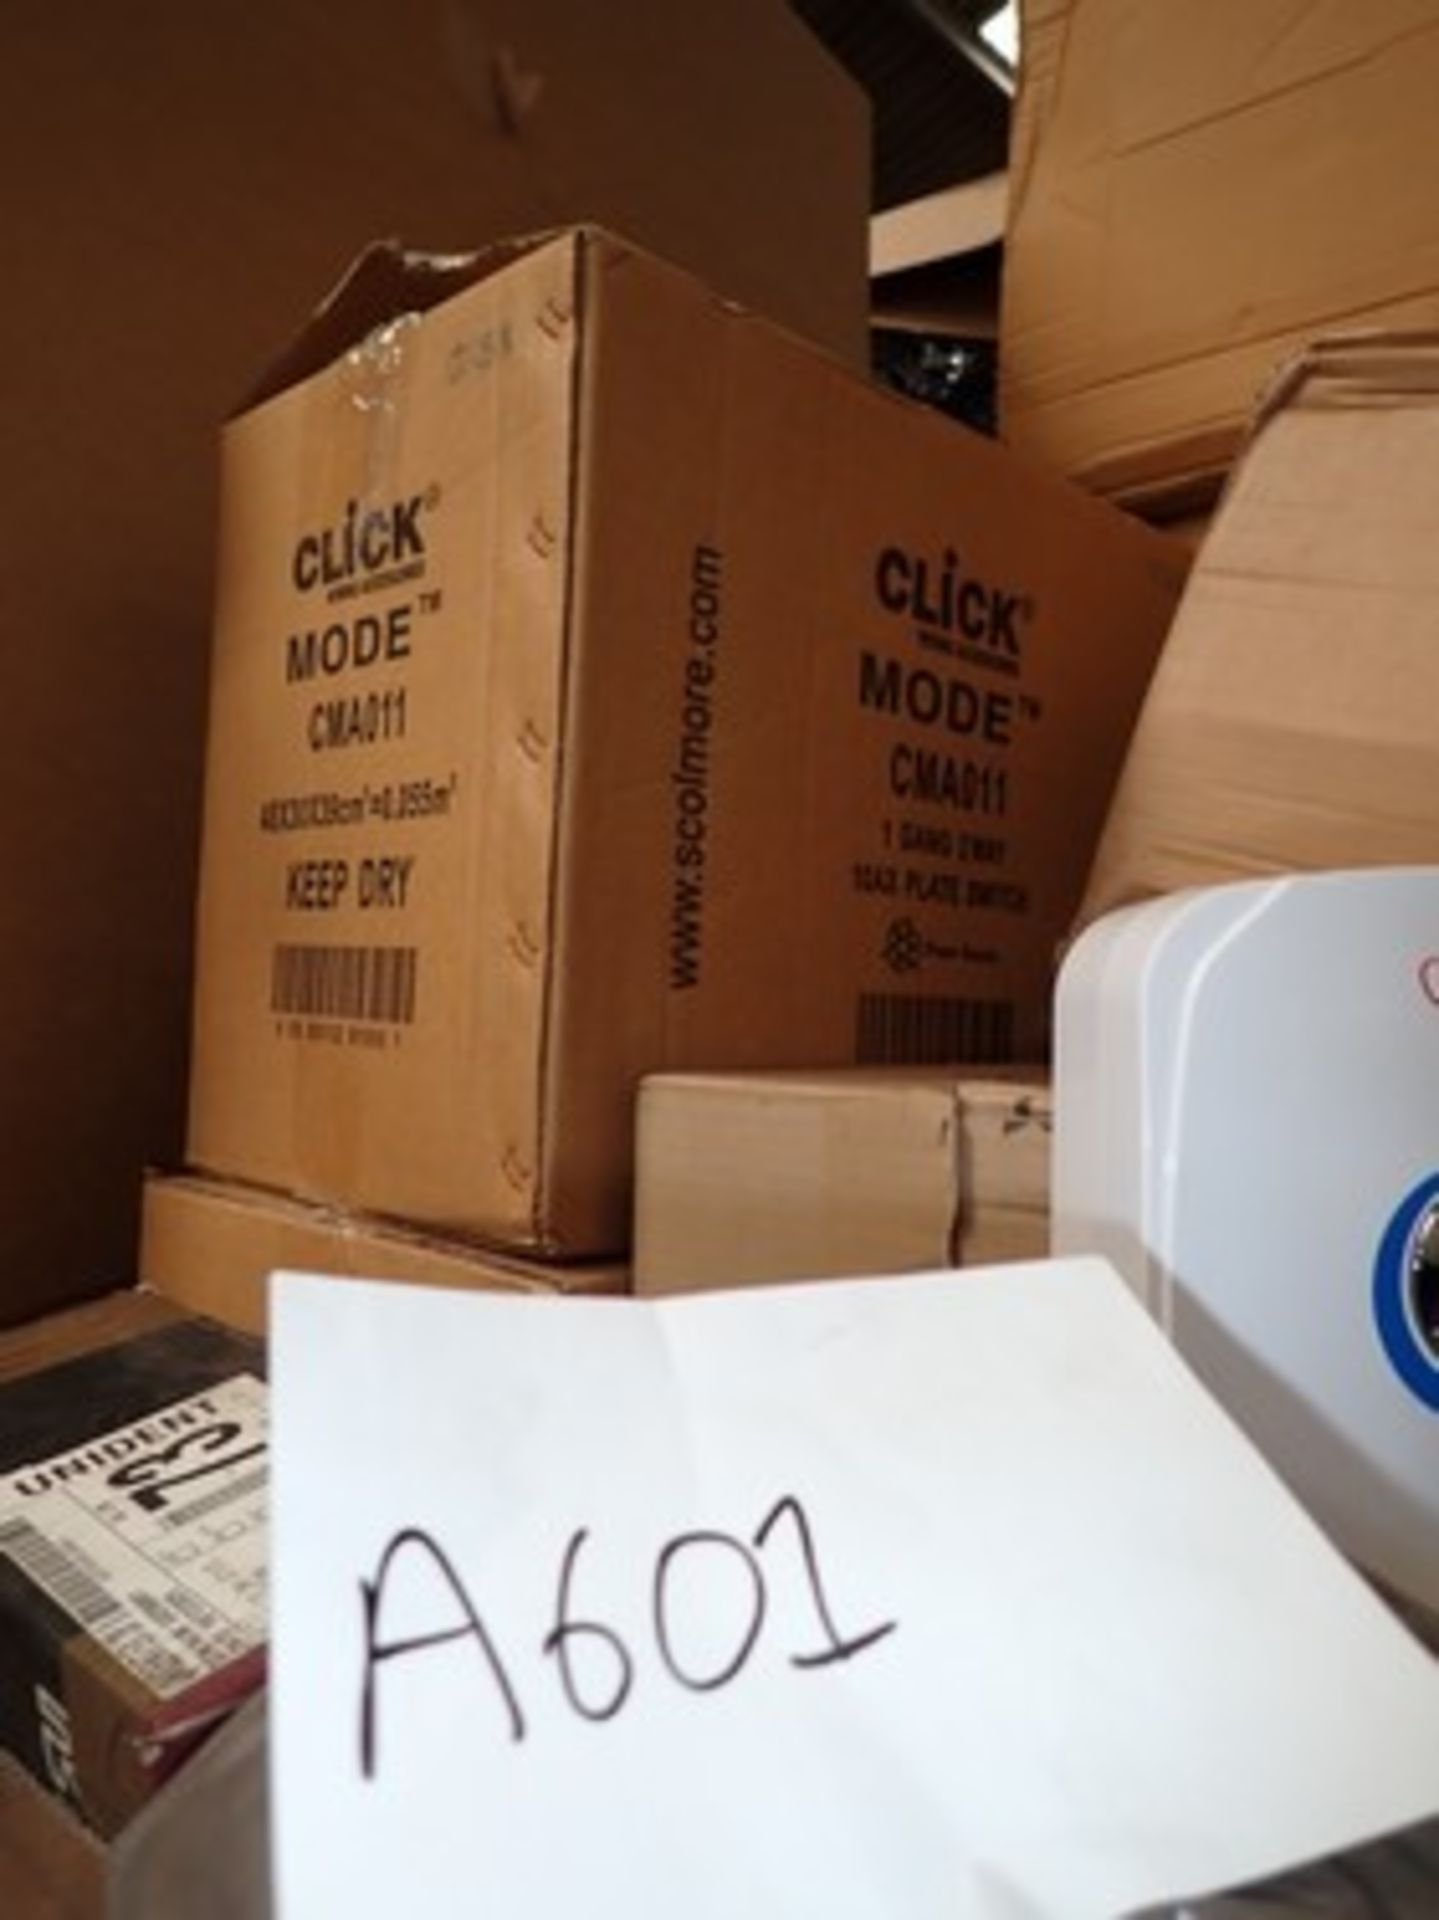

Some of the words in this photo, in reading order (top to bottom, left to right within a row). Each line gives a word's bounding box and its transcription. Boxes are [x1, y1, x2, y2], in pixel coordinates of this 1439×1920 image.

[306, 687, 407, 752] CMA011
[669, 547, 723, 990] www.scolmore.com
[889, 742, 1009, 815] CMA011
[286, 860, 350, 910] KEEP
[357, 855, 416, 909] DRY
[14, 1399, 218, 1497] UNIDENT
[359, 1494, 898, 1779] A601
